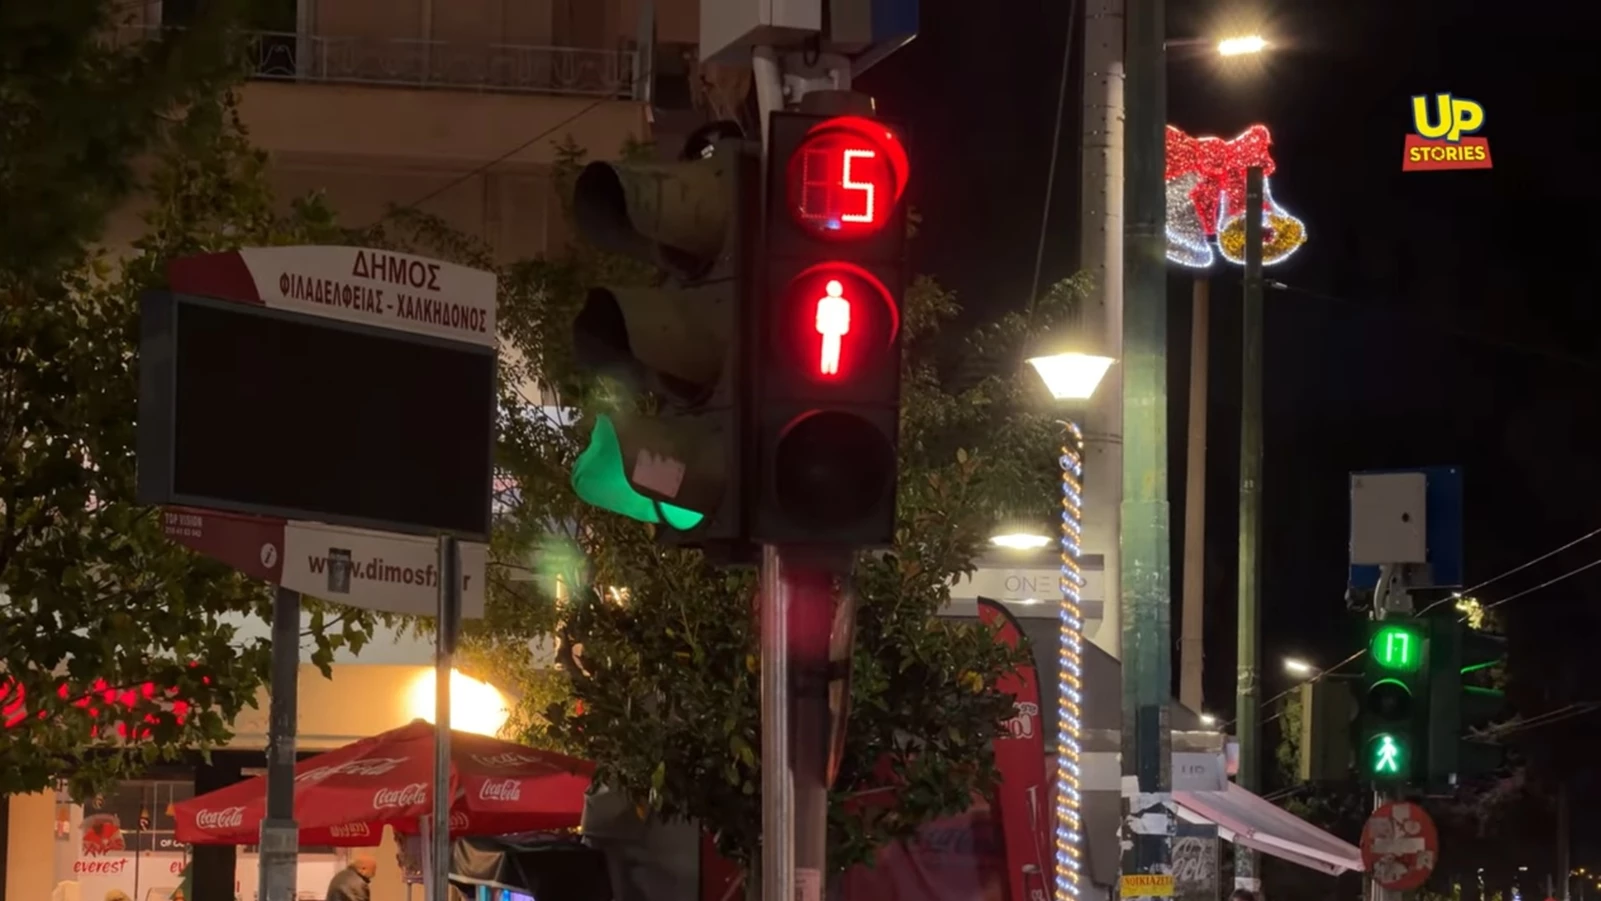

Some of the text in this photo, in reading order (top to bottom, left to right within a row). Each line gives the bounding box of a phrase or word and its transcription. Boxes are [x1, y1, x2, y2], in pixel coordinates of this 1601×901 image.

[841, 149, 875, 222] 5
[352, 250, 441, 291] ΔΗΜΟΣ
[279, 272, 383, 313] ΦΙΛΑΔΕΛΦΕΙΑΣ
[396, 293, 487, 333] ΧΑΛΚΗΔΟΝΟΣ
[1004, 575, 1050, 592] ONE
[1386, 632, 1409, 664] 17
[73, 858, 128, 873] everest
